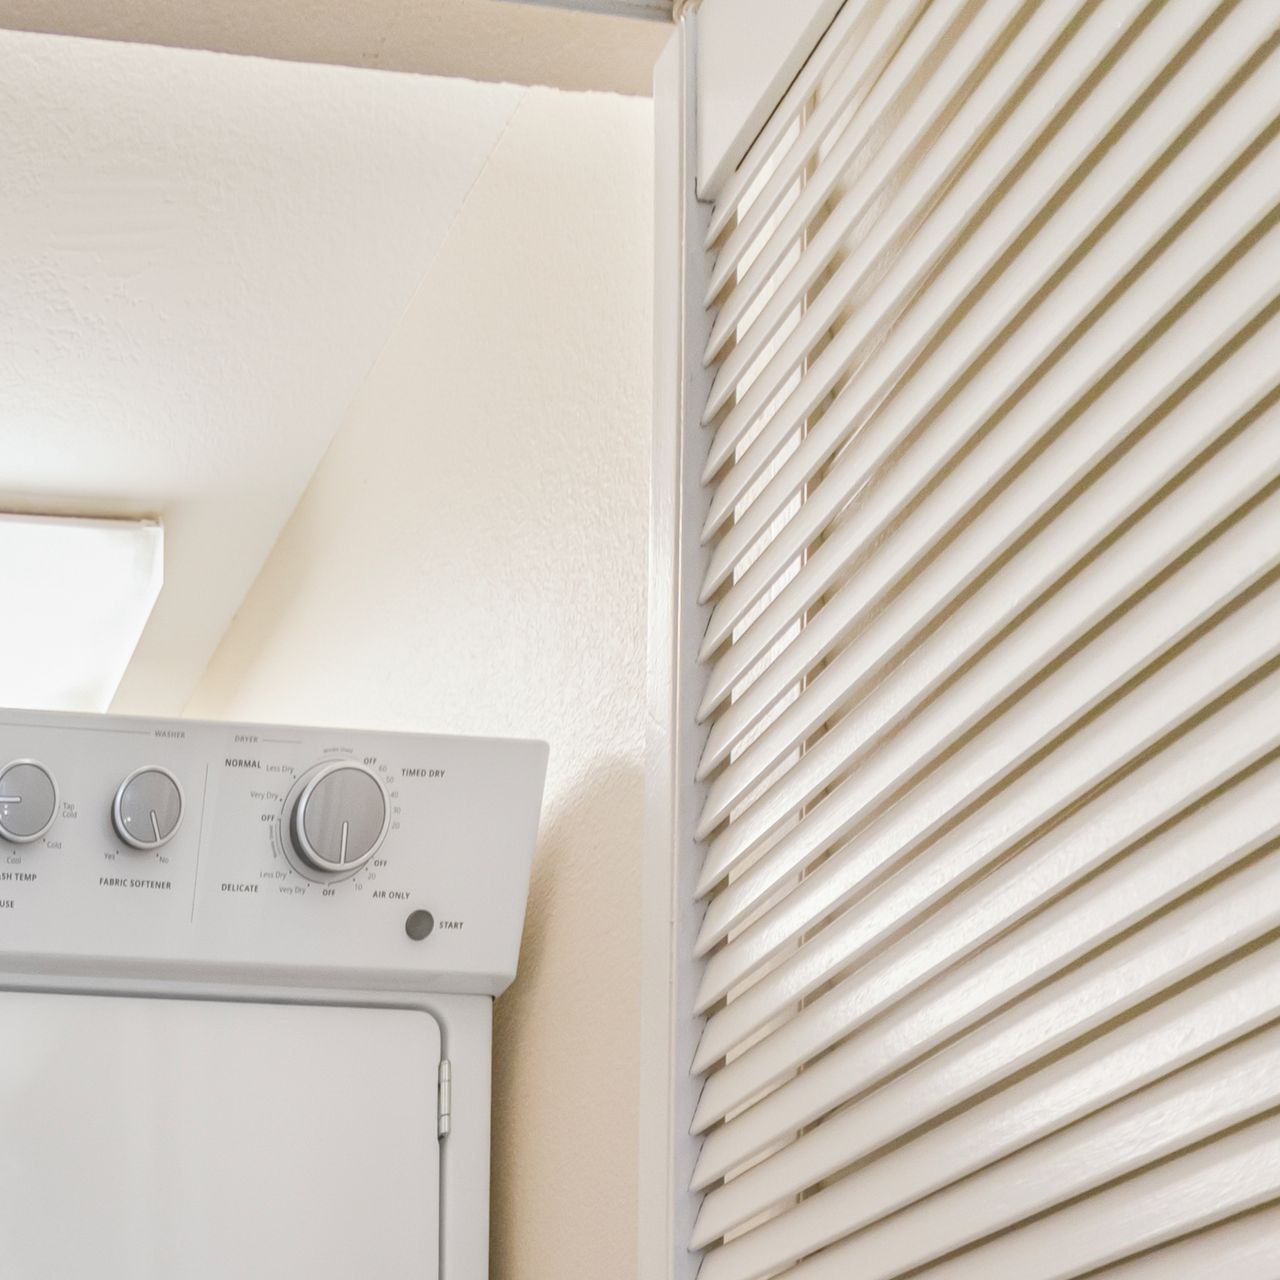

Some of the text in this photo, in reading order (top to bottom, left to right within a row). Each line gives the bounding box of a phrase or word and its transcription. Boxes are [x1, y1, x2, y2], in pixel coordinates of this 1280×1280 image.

[154, 730, 185, 739] WASHER
[234, 735, 258, 743] DRYER
[225, 758, 261, 769] NORMAL
[363, 757, 376, 765] OFF
[266, 764, 294, 775] Less Dry
[401, 768, 446, 779] TIMED DRY
[250, 791, 279, 802] Very Dry
[260, 814, 275, 822] OFF
[46, 841, 62, 849] Cold
[6, 856, 22, 865] Cool
[103, 852, 116, 861] Yes
[373, 859, 388, 867] OFF
[14, 872, 37, 882] TEMP
[260, 871, 288, 880] Less Dry
[99, 877, 171, 890] FABRIC SOFTENER
[221, 883, 259, 893] DELICATE
[279, 887, 306, 895] Very Dry
[322, 889, 335, 897] OFF
[372, 890, 411, 900] AIR ONLY
[439, 921, 464, 930] START
